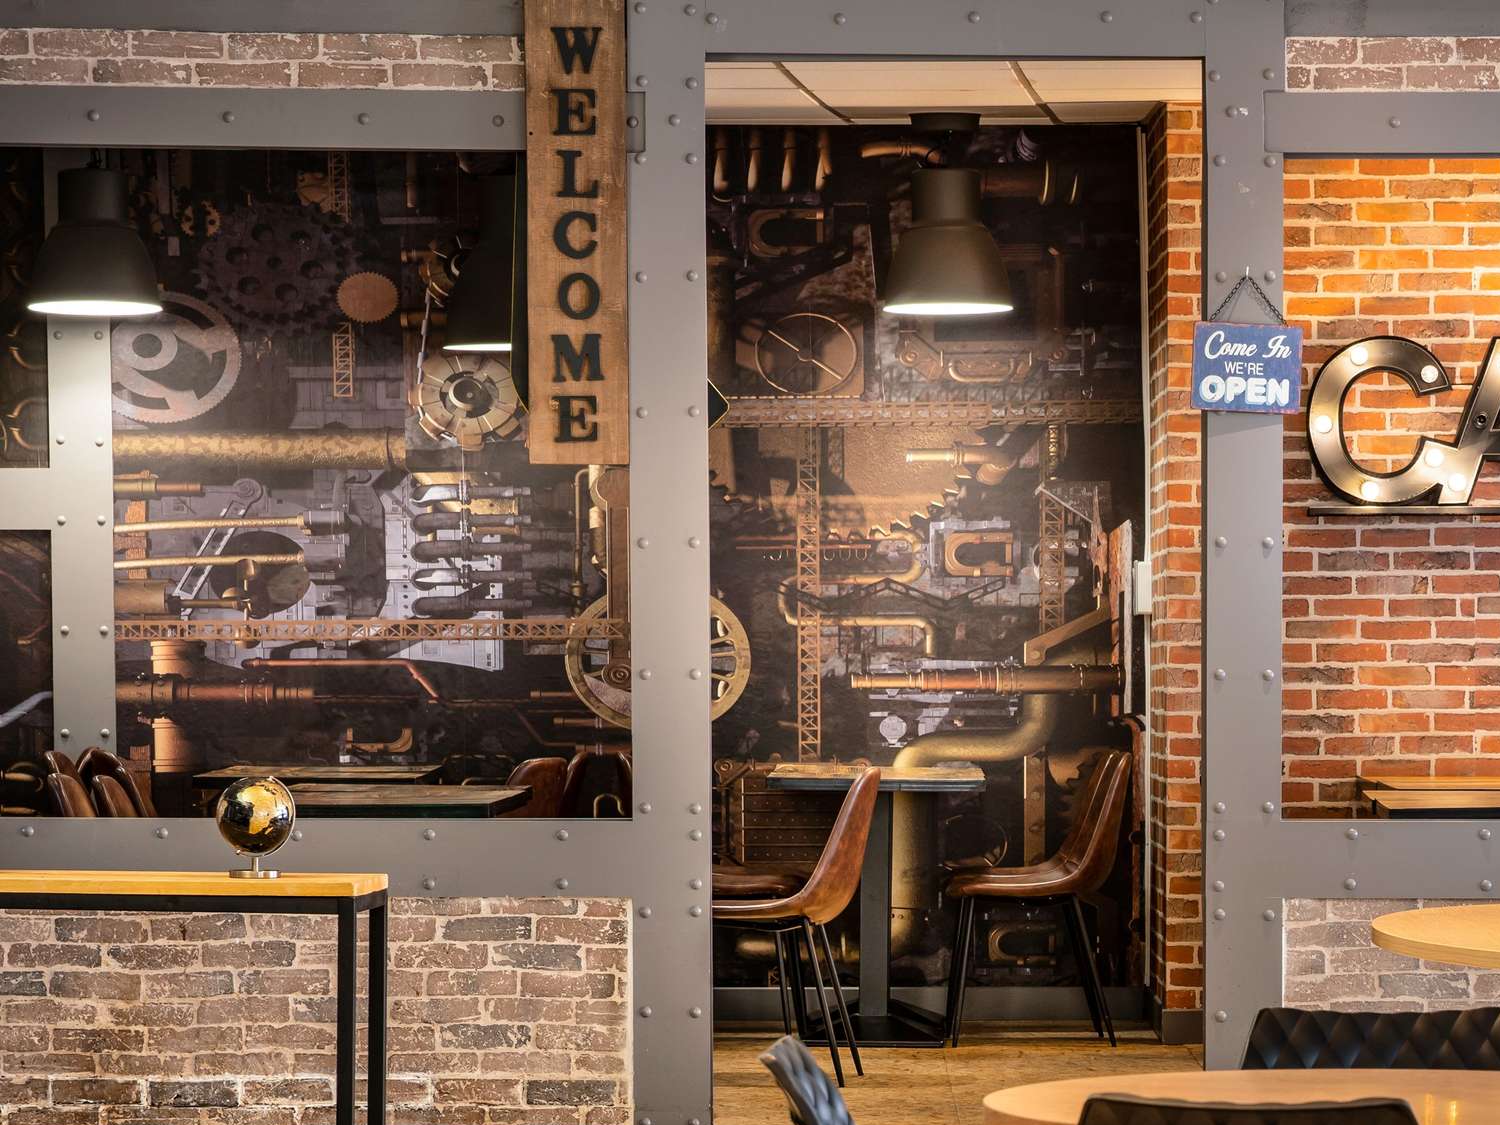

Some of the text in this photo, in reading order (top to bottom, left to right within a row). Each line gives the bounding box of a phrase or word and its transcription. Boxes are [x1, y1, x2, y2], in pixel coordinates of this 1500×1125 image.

[550, 26, 605, 443] WELCOME
[1204, 330, 1293, 360] Come In
[1224, 361, 1265, 375] WE'RE
[1199, 375, 1290, 407] OPEN
